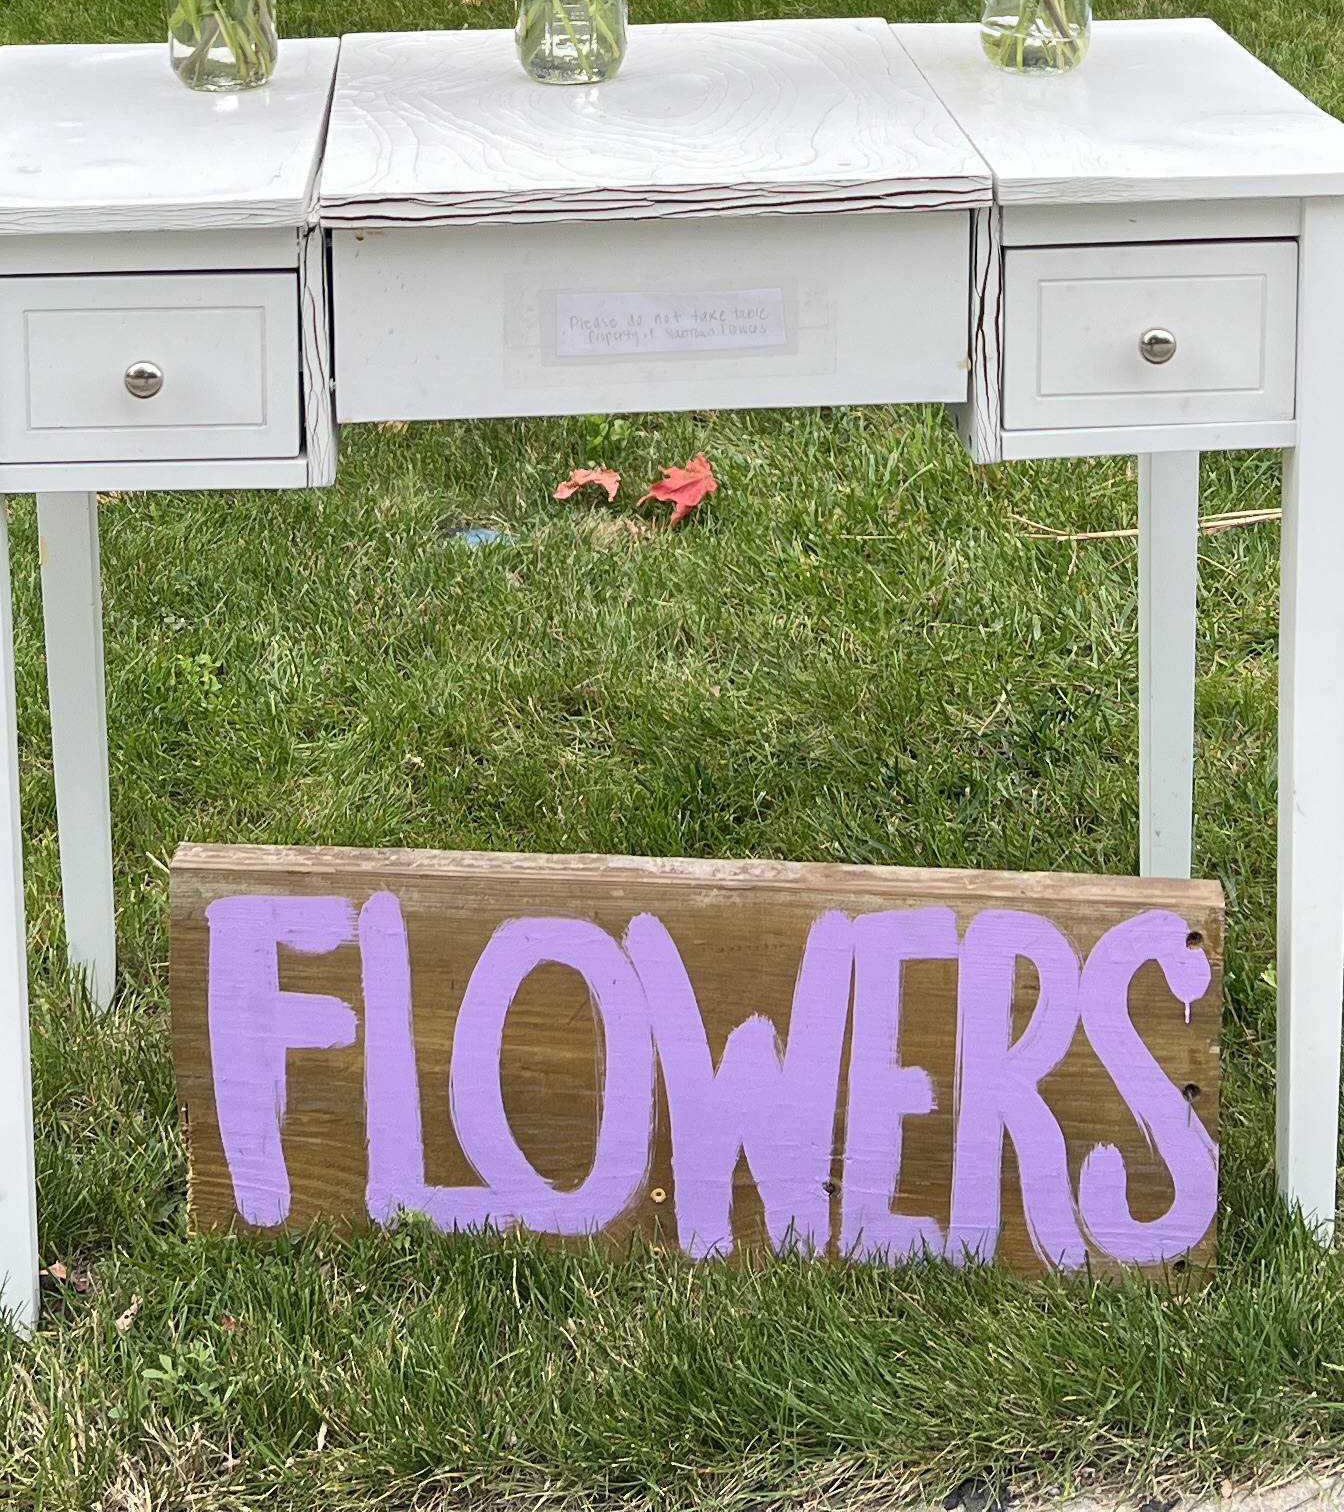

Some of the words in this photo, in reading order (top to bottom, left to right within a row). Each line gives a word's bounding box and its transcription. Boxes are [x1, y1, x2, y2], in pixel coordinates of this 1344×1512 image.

[569, 315, 618, 330] Please
[627, 313, 643, 327] do
[655, 311, 682, 325] not
[690, 309, 727, 323] take
[733, 306, 769, 321] table
[205, 890, 1219, 1270] FLOWERS
